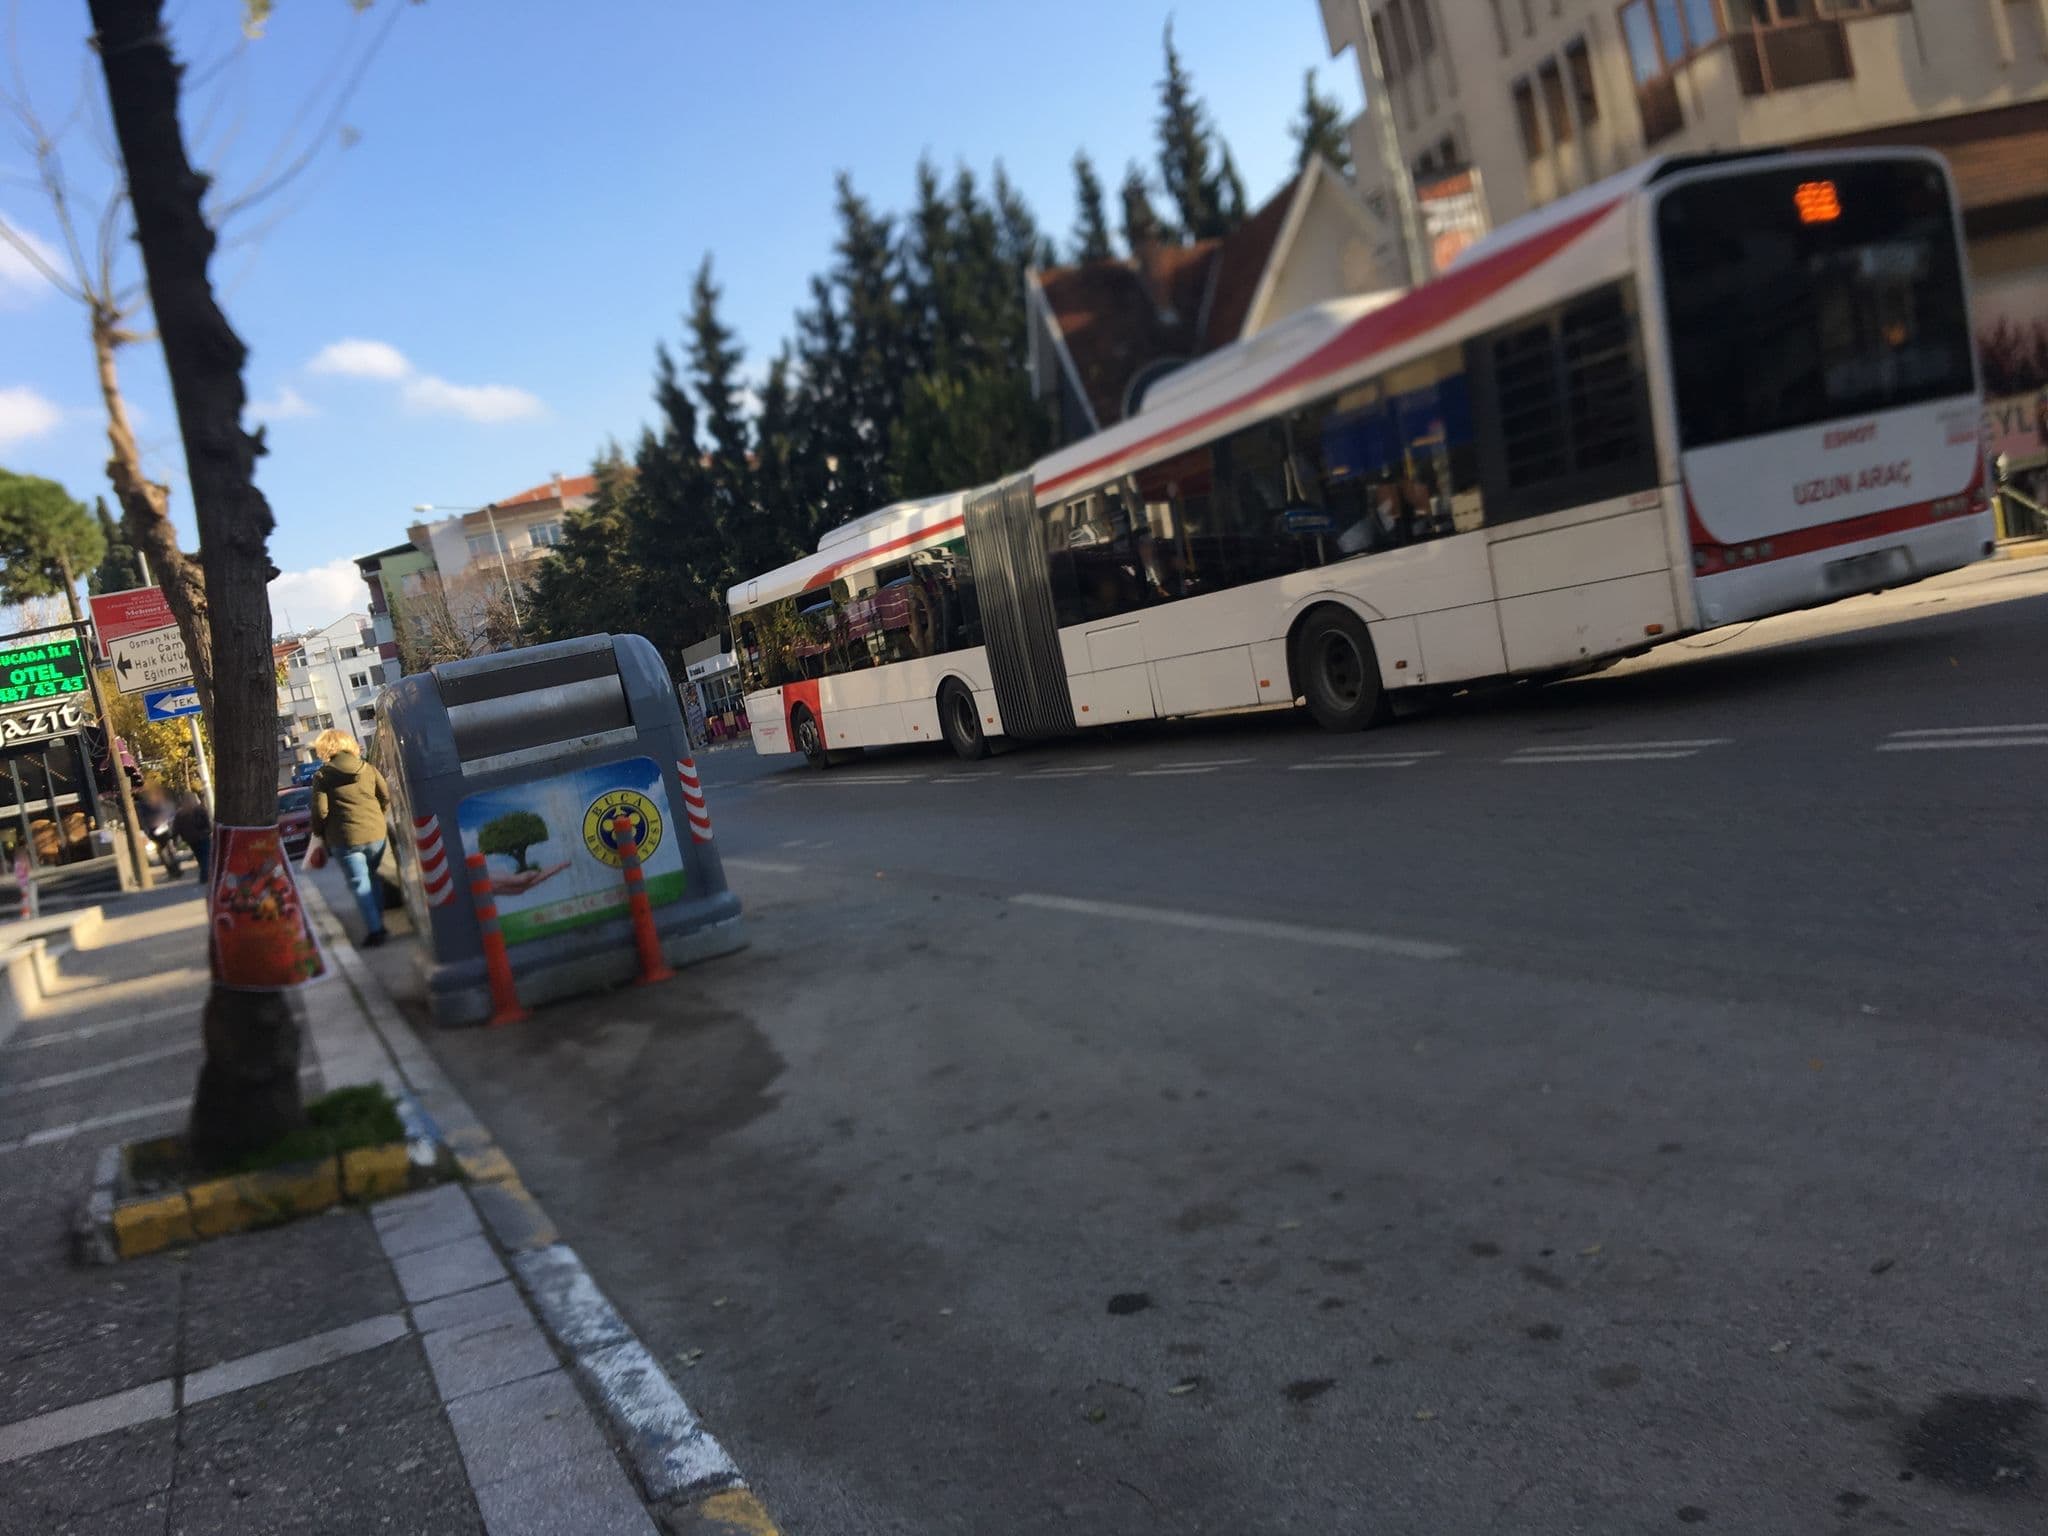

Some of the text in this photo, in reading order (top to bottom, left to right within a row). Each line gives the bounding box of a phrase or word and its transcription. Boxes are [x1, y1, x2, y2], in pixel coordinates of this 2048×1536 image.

[1793, 460, 1911, 505] UZUN ARAÇ
[129, 632, 180, 649] Osman Nur
[157, 641, 183, 652] Cam
[0, 649, 46, 667] UCADA
[135, 650, 184, 669] Halk Kütü
[10, 663, 63, 685] OTEL
[144, 662, 189, 681] Eğitim M
[34, 681, 56, 696] 43
[61, 677, 83, 692] 43
[173, 697, 194, 707] TEK
[592, 793, 642, 817] BUCA
